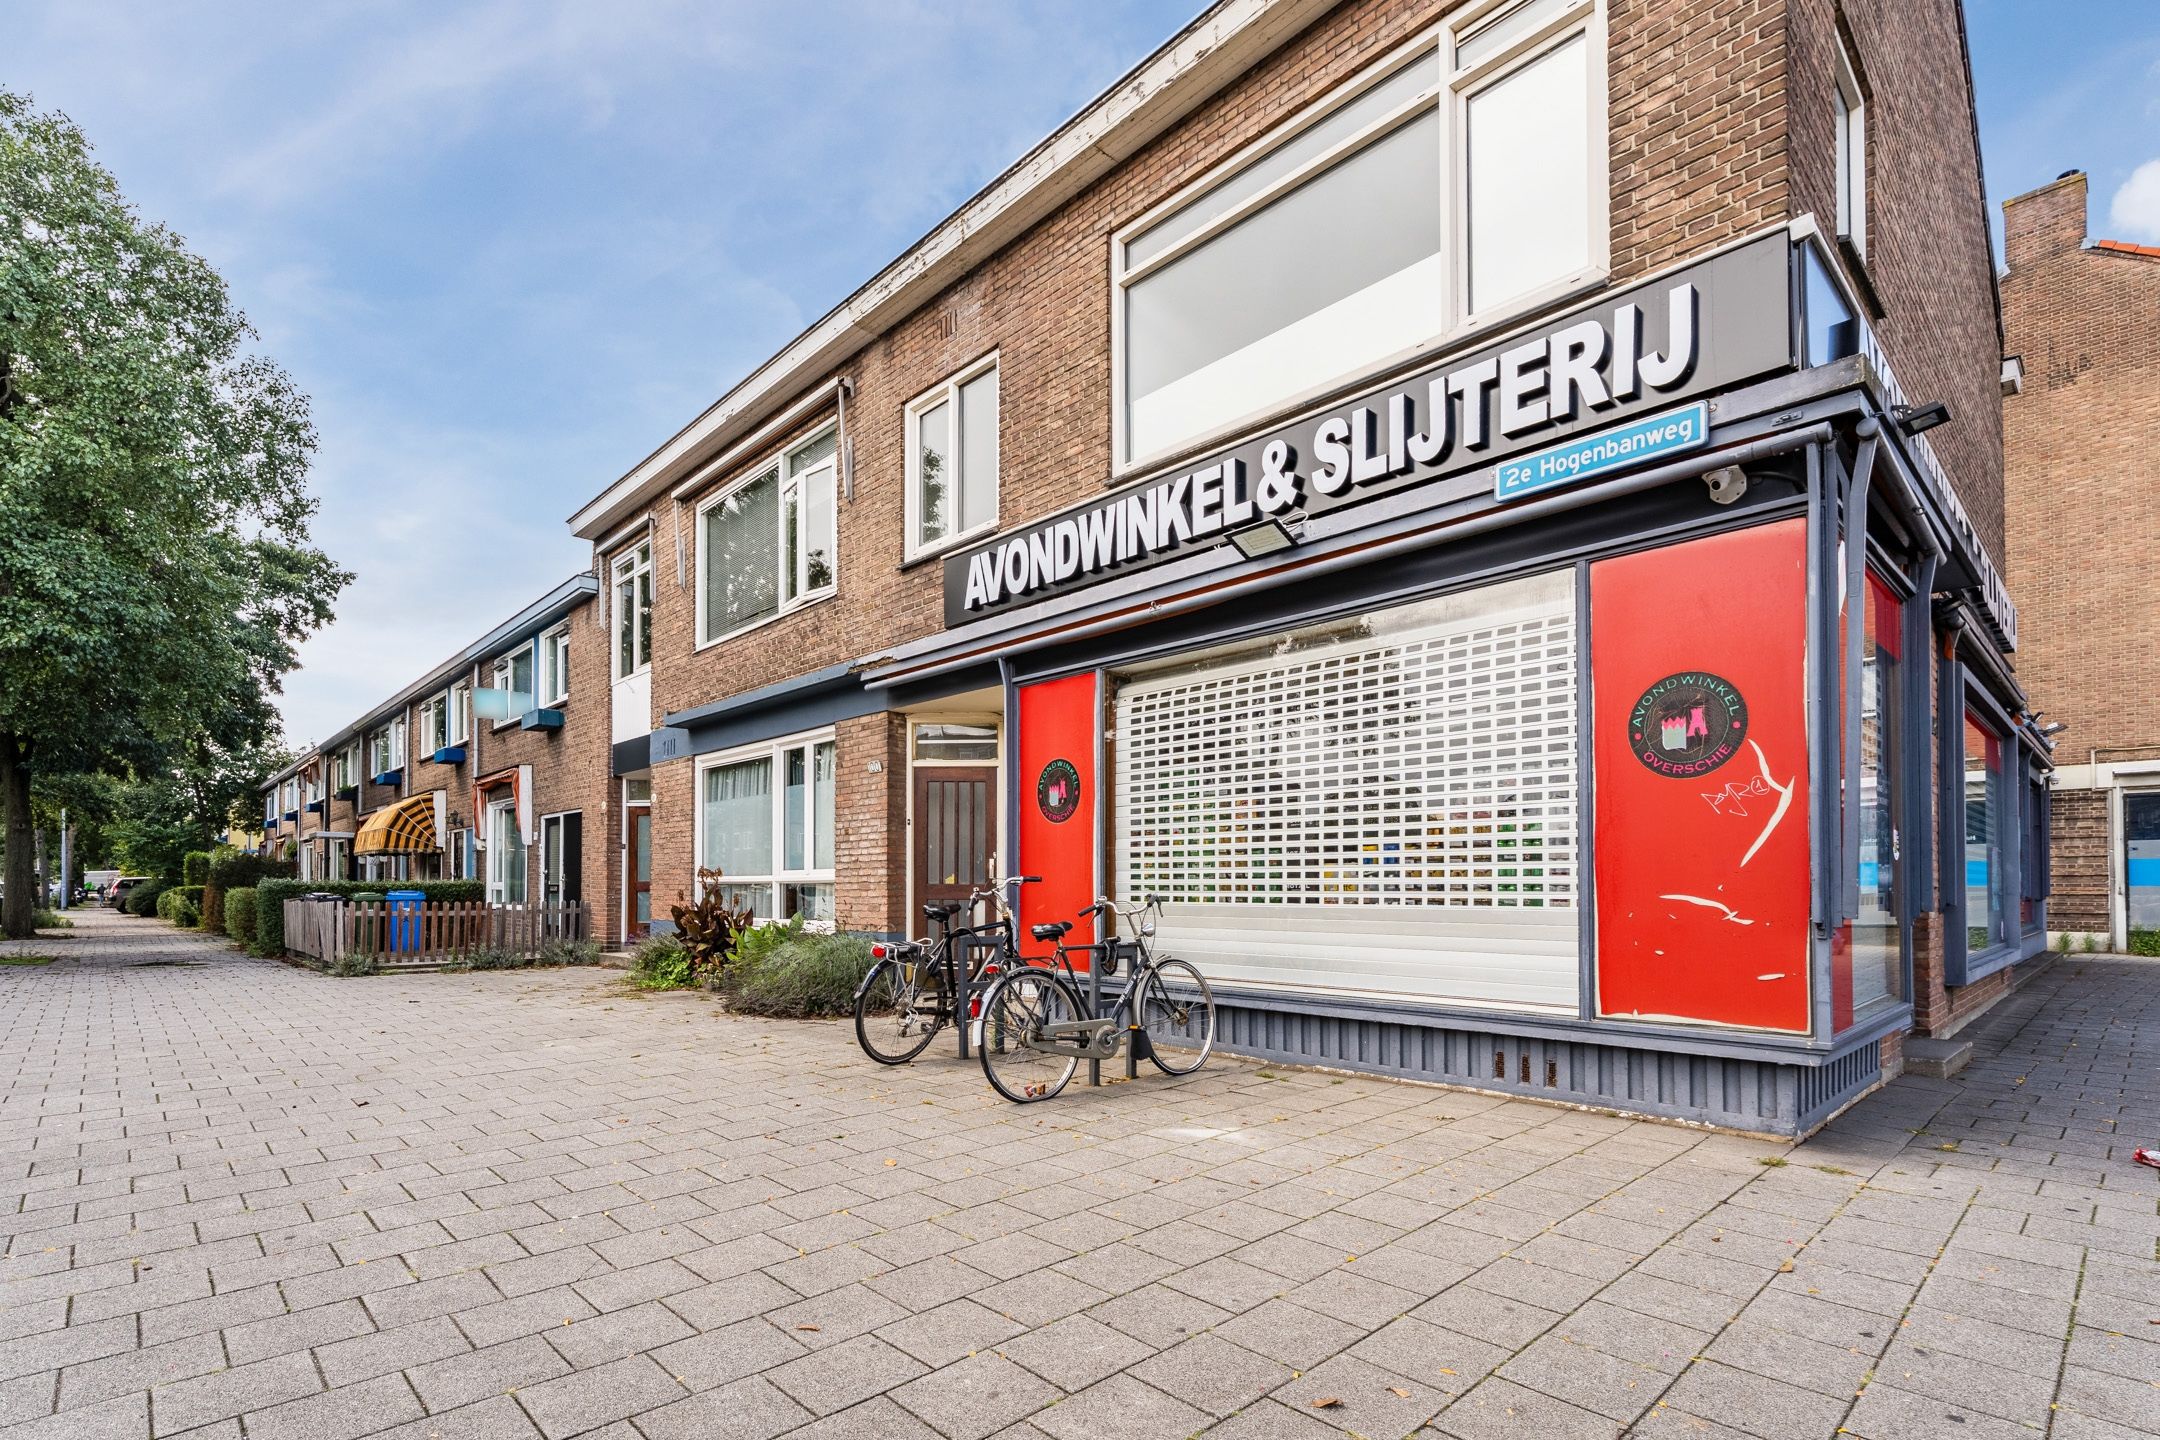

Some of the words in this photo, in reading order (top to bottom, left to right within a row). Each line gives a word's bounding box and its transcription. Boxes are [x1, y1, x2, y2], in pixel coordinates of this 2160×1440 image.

[964, 457, 1255, 611] AVONDWINKEL
[1256, 439, 1300, 513] &
[1311, 282, 1695, 495] SLIJTERIJ
[1504, 467, 1532, 488] 2e
[1540, 418, 1693, 478] Hogenbanweg
[1632, 674, 1741, 727] AVONDWINKEL
[1039, 760, 1079, 790] AVONDWINKEL
[1643, 743, 1733, 775] OVERSCHIE
